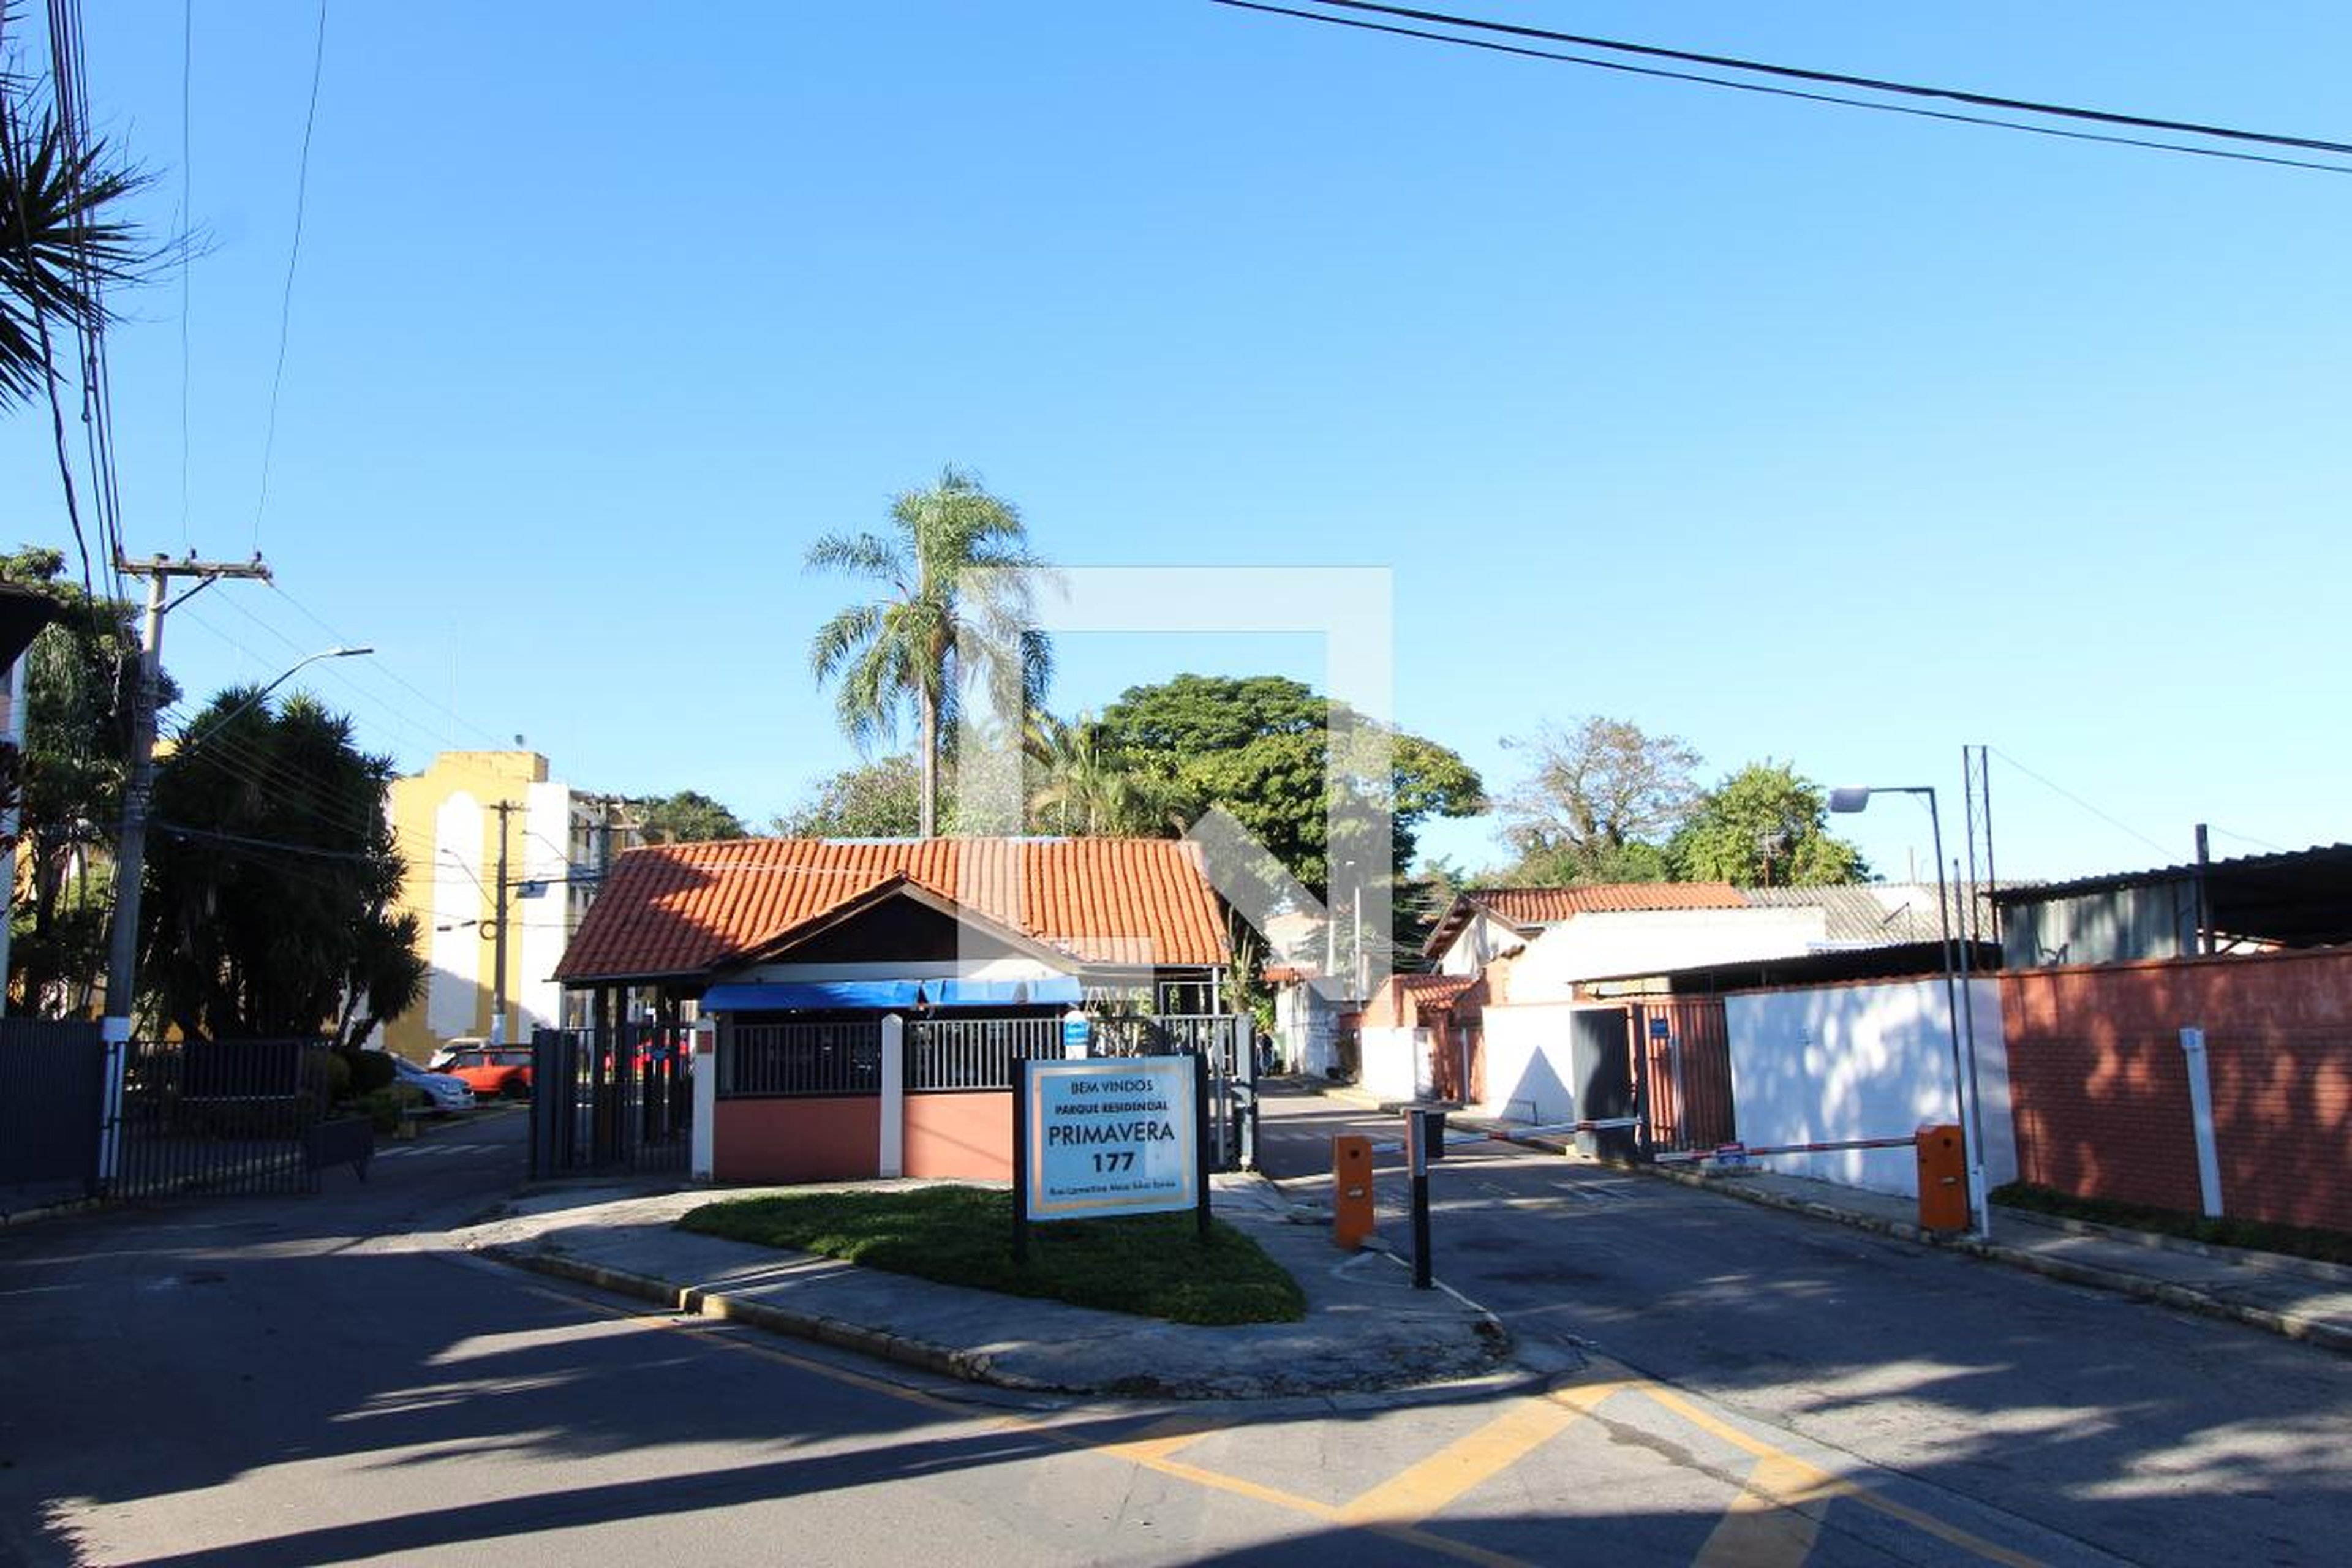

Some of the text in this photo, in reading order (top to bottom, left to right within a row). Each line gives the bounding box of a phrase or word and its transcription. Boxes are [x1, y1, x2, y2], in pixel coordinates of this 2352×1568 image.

[1072, 1080, 1153, 1095] BEM VINDOS
[1055, 1103, 1099, 1115] PARQUE
[1049, 1121, 1175, 1145] PRIMAVERA
[1093, 1152, 1134, 1172] 177
